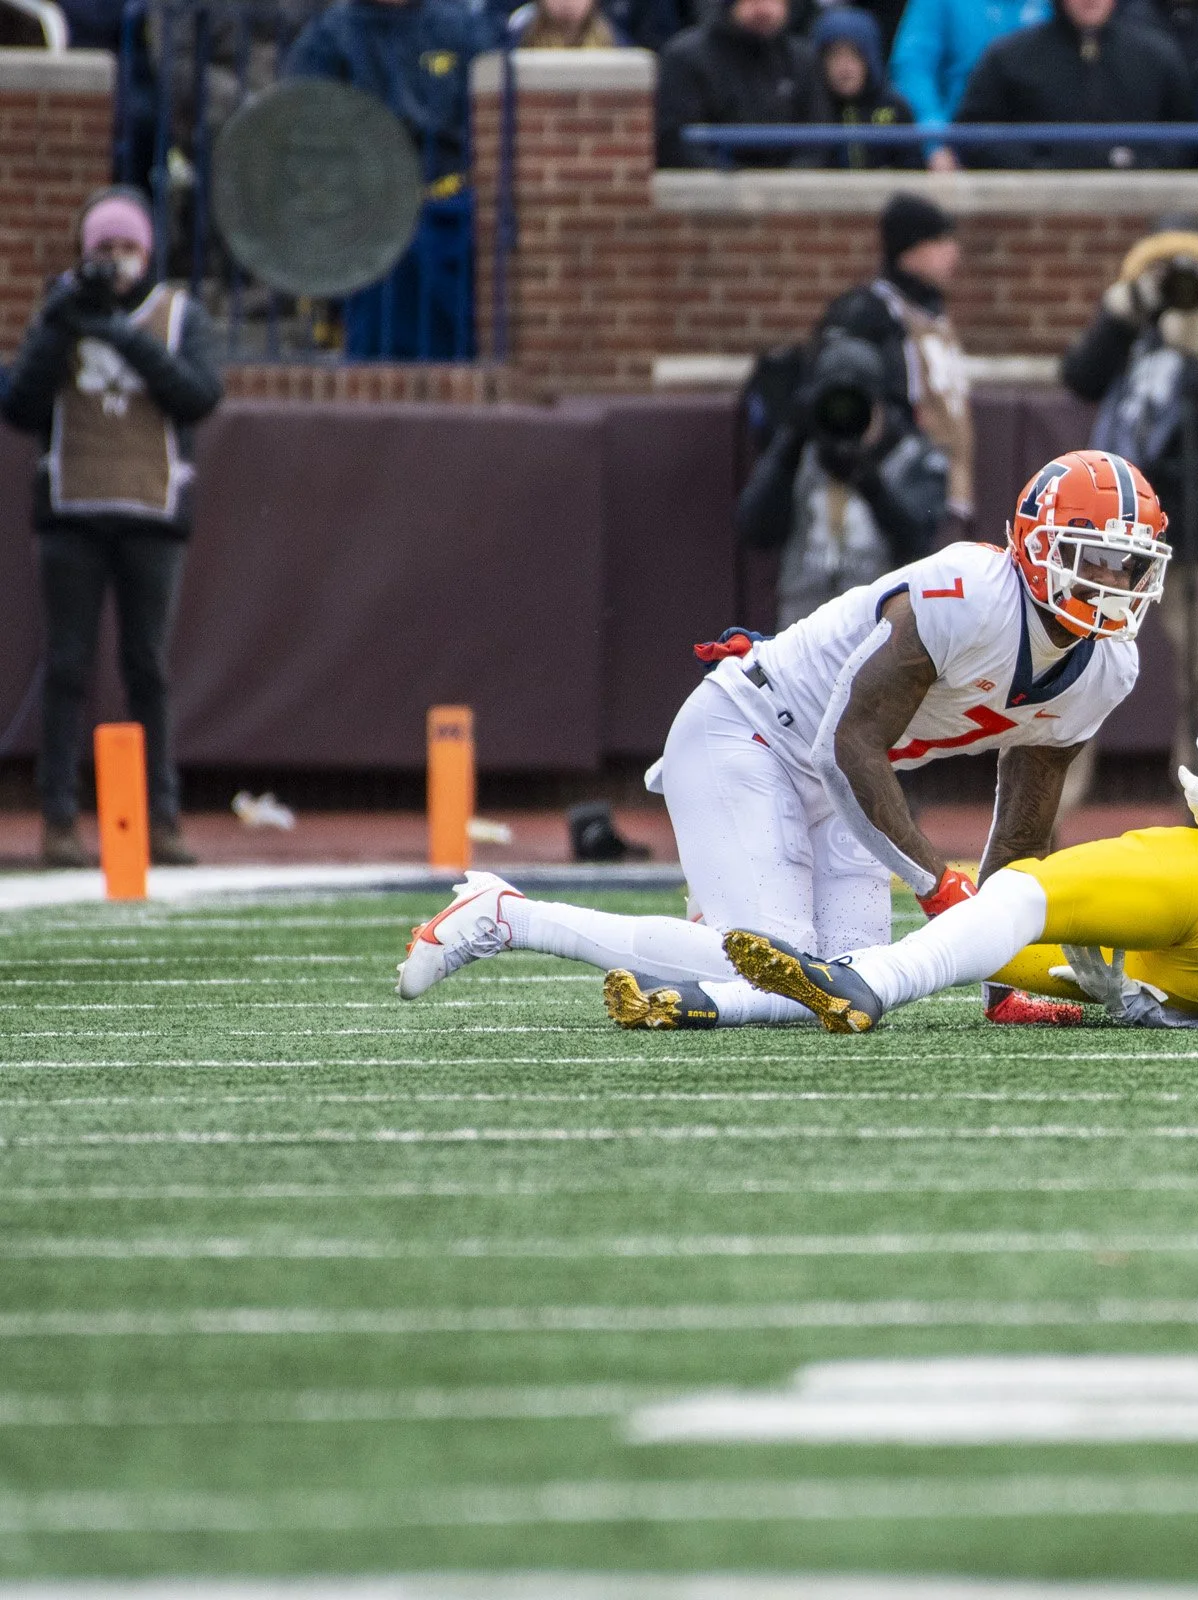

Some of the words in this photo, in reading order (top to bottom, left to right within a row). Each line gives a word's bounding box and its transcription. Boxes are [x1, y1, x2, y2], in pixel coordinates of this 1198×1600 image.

[1123, 523, 1135, 536] I
[922, 576, 965, 599] 7
[886, 703, 1019, 763] 7
